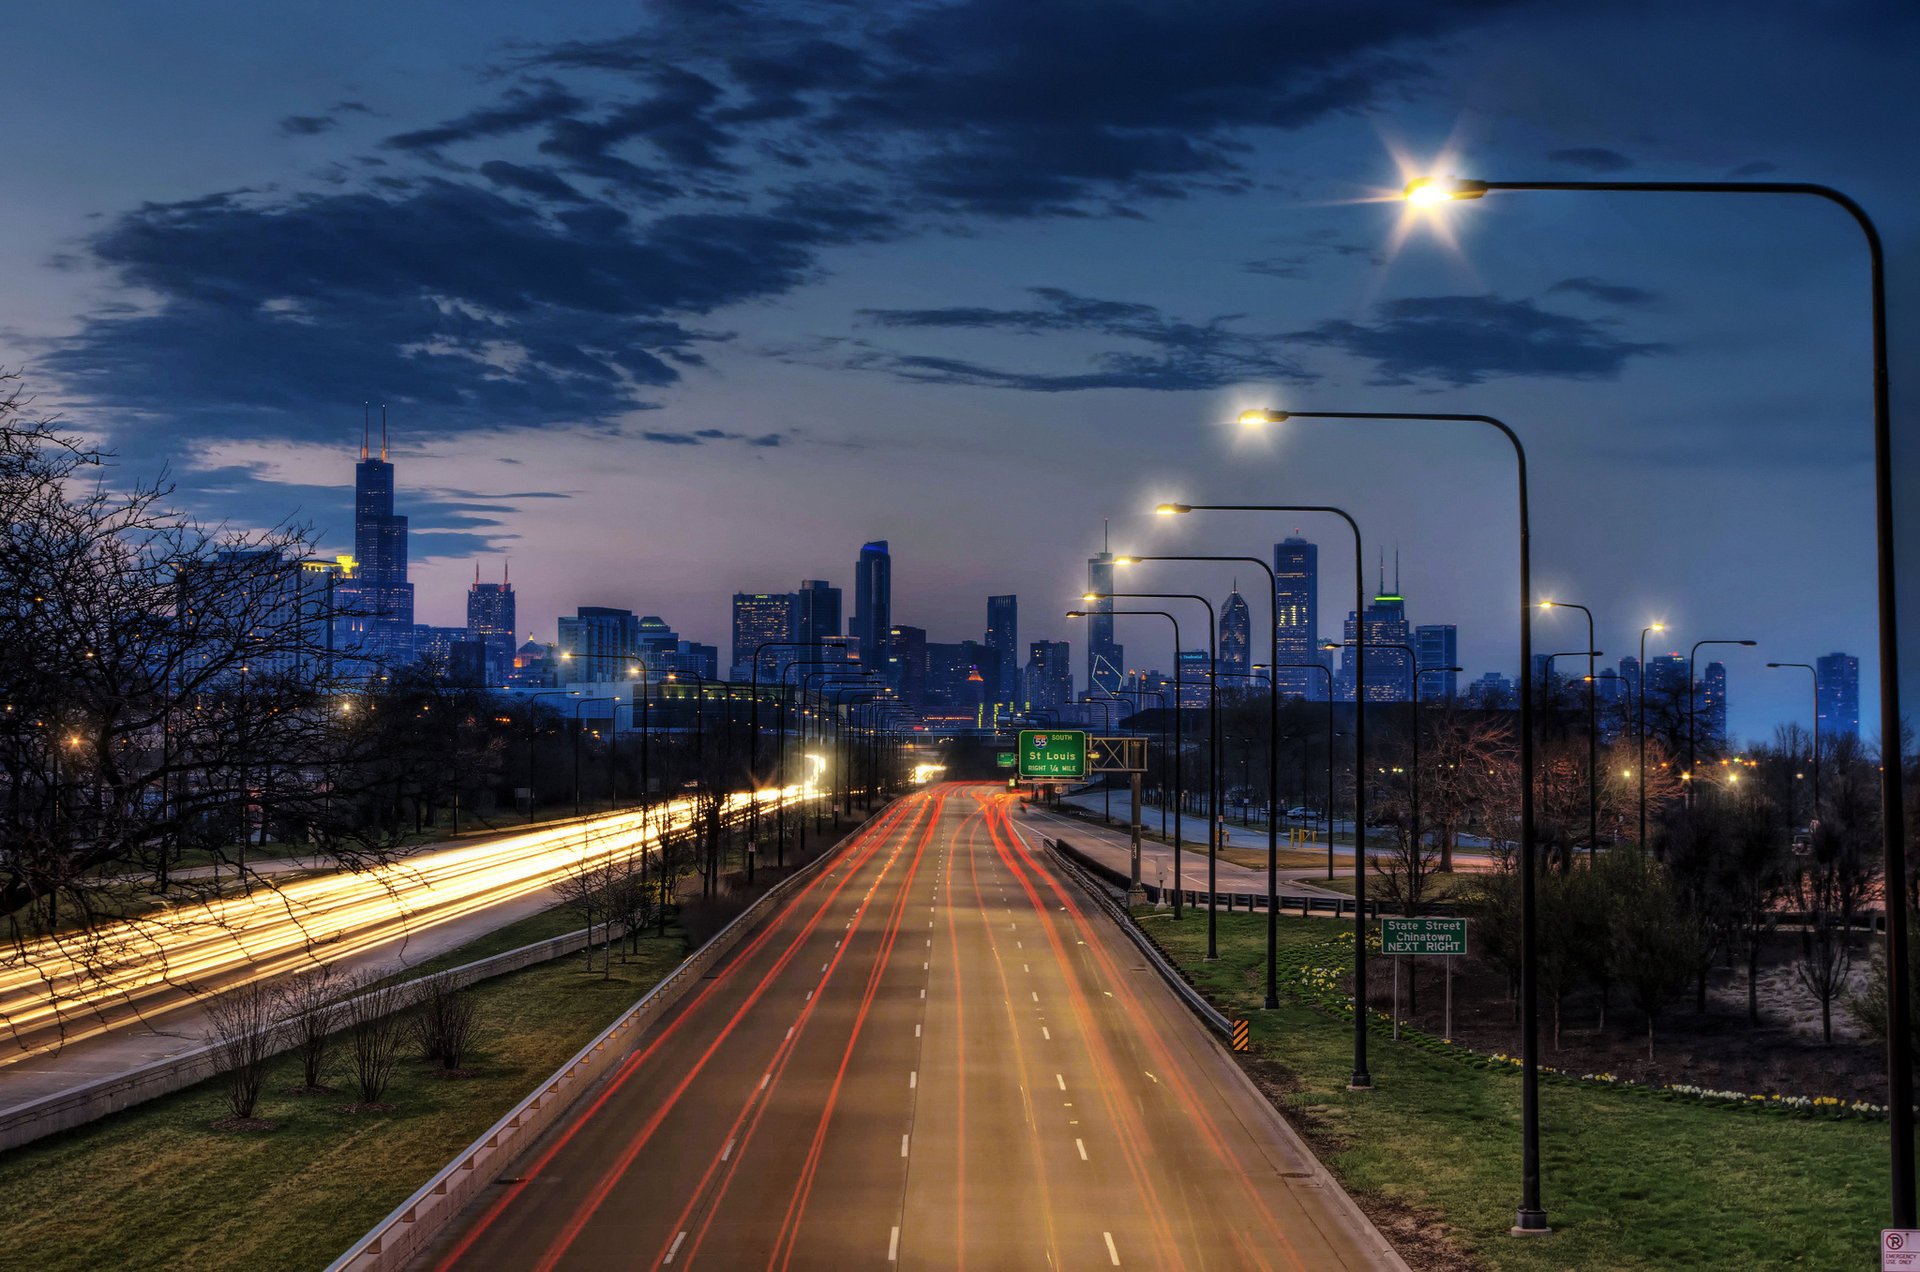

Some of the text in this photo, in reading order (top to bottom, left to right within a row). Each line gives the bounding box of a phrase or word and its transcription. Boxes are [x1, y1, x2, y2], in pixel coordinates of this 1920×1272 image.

[1030, 752, 1076, 760] St Louis
[1388, 921, 1460, 930] State Street
[1396, 932, 1452, 942] Chinatown
[1388, 942, 1460, 951] NEXT RIGHT
